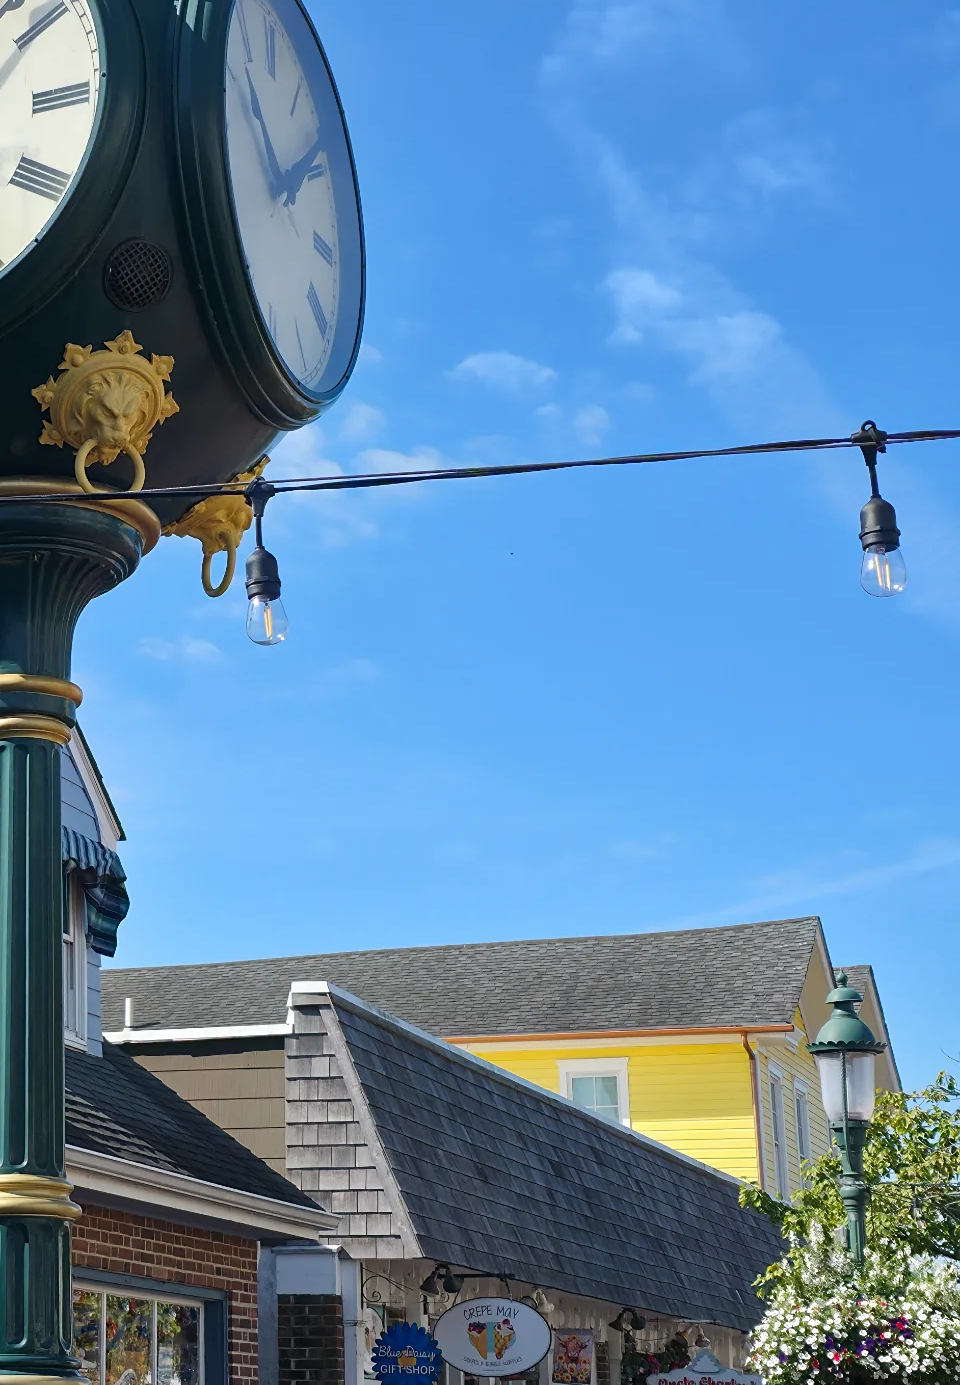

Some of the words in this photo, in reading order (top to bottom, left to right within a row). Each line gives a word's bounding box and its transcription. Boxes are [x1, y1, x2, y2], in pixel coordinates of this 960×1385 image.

[463, 1305, 493, 1321] CREPE
[378, 1345, 403, 1358] Blue
[405, 1345, 436, 1361] Daisy
[380, 1365, 403, 1374] GIFT
[406, 1365, 435, 1375] SHOP
